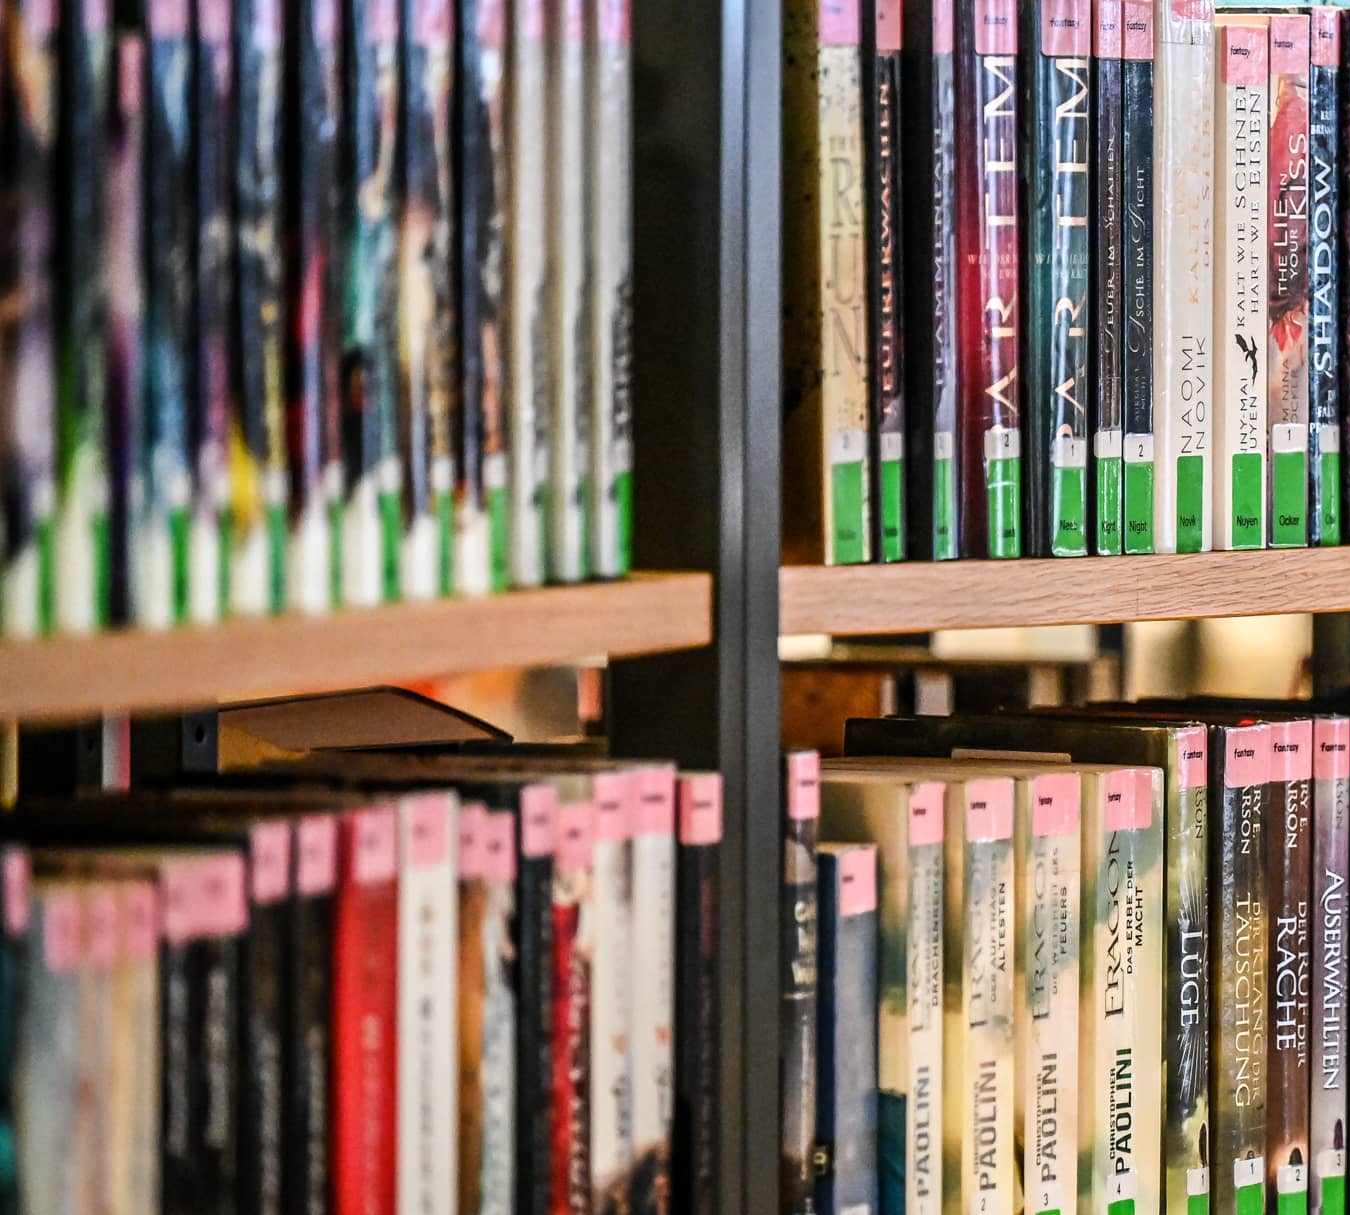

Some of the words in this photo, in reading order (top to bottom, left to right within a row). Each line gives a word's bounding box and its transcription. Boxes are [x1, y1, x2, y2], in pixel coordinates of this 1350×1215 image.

[1249, 92, 1261, 186] EISEN
[1279, 173, 1288, 192] IN
[1289, 133, 1307, 220] KISS
[984, 56, 1017, 433] ARTEM
[1236, 222, 1246, 265] WIE
[1251, 200, 1261, 244] WIE
[1275, 199, 1287, 247] LIE
[1136, 246, 1145, 267] IM
[1251, 251, 1261, 313] HART
[1276, 260, 1287, 296] THE
[1289, 229, 1299, 280] YOUR
[1313, 155, 1332, 372] SHADOW
[1236, 271, 1246, 328] KALT
[1181, 335, 1193, 454] NAOMI
[1195, 336, 1206, 450] NOVIK
[1282, 358, 1291, 401] NINA
[1138, 444, 1145, 457] 2
[1129, 521, 1147, 534] Night
[1236, 515, 1258, 528] Nuyen
[997, 881, 1005, 972] ÄLTESTEN
[1059, 886, 1067, 955] FEUERS
[1135, 886, 1143, 948] MACHT
[1252, 901, 1261, 941] DER
[1297, 901, 1308, 945] DER
[1180, 929, 1203, 1027] LÜGE
[1235, 892, 1252, 1108] TÄUSCHUNG
[1252, 947, 1264, 1056] KLANG
[1276, 916, 1297, 1051] RACHE
[1321, 868, 1345, 1090] AUSERWÄHLTEN
[916, 1066, 930, 1198] PAOLINI
[980, 1061, 996, 1191] PAOLINI
[1041, 1053, 1057, 1183] PAOLINI
[1115, 1048, 1132, 1177] PAOLINI
[1042, 1193, 1049, 1207] 3
[1295, 1168, 1301, 1182] 2
